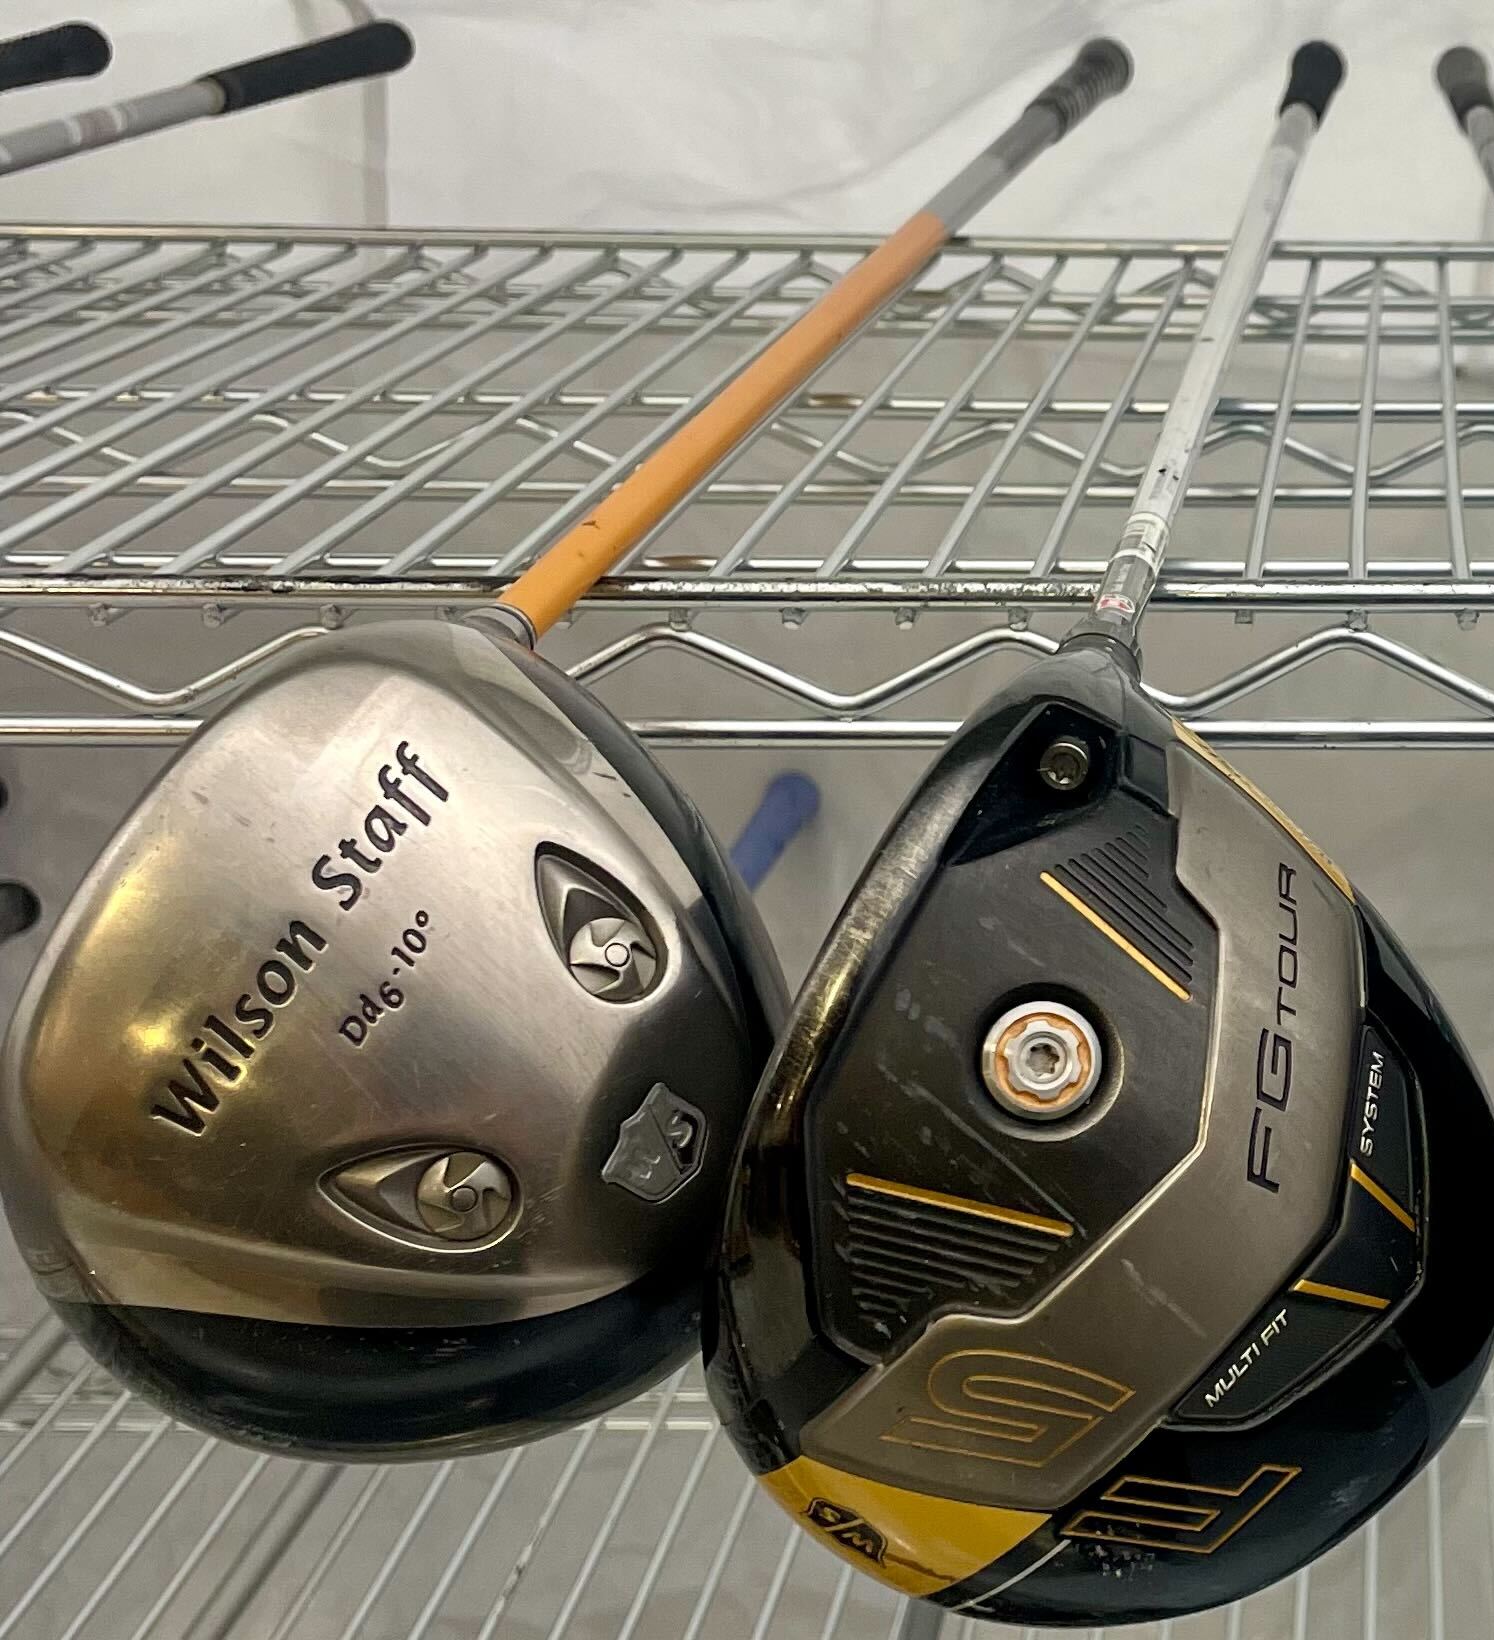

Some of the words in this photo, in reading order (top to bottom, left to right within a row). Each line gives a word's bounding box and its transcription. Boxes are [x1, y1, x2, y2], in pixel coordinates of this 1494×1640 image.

[152, 919, 329, 1137] Wilson
[311, 740, 450, 911] Staff
[1360, 1051, 1384, 1156] SYSTEM
[1204, 1341, 1262, 1408] MULTI
[1261, 1308, 1289, 1347] FIT
